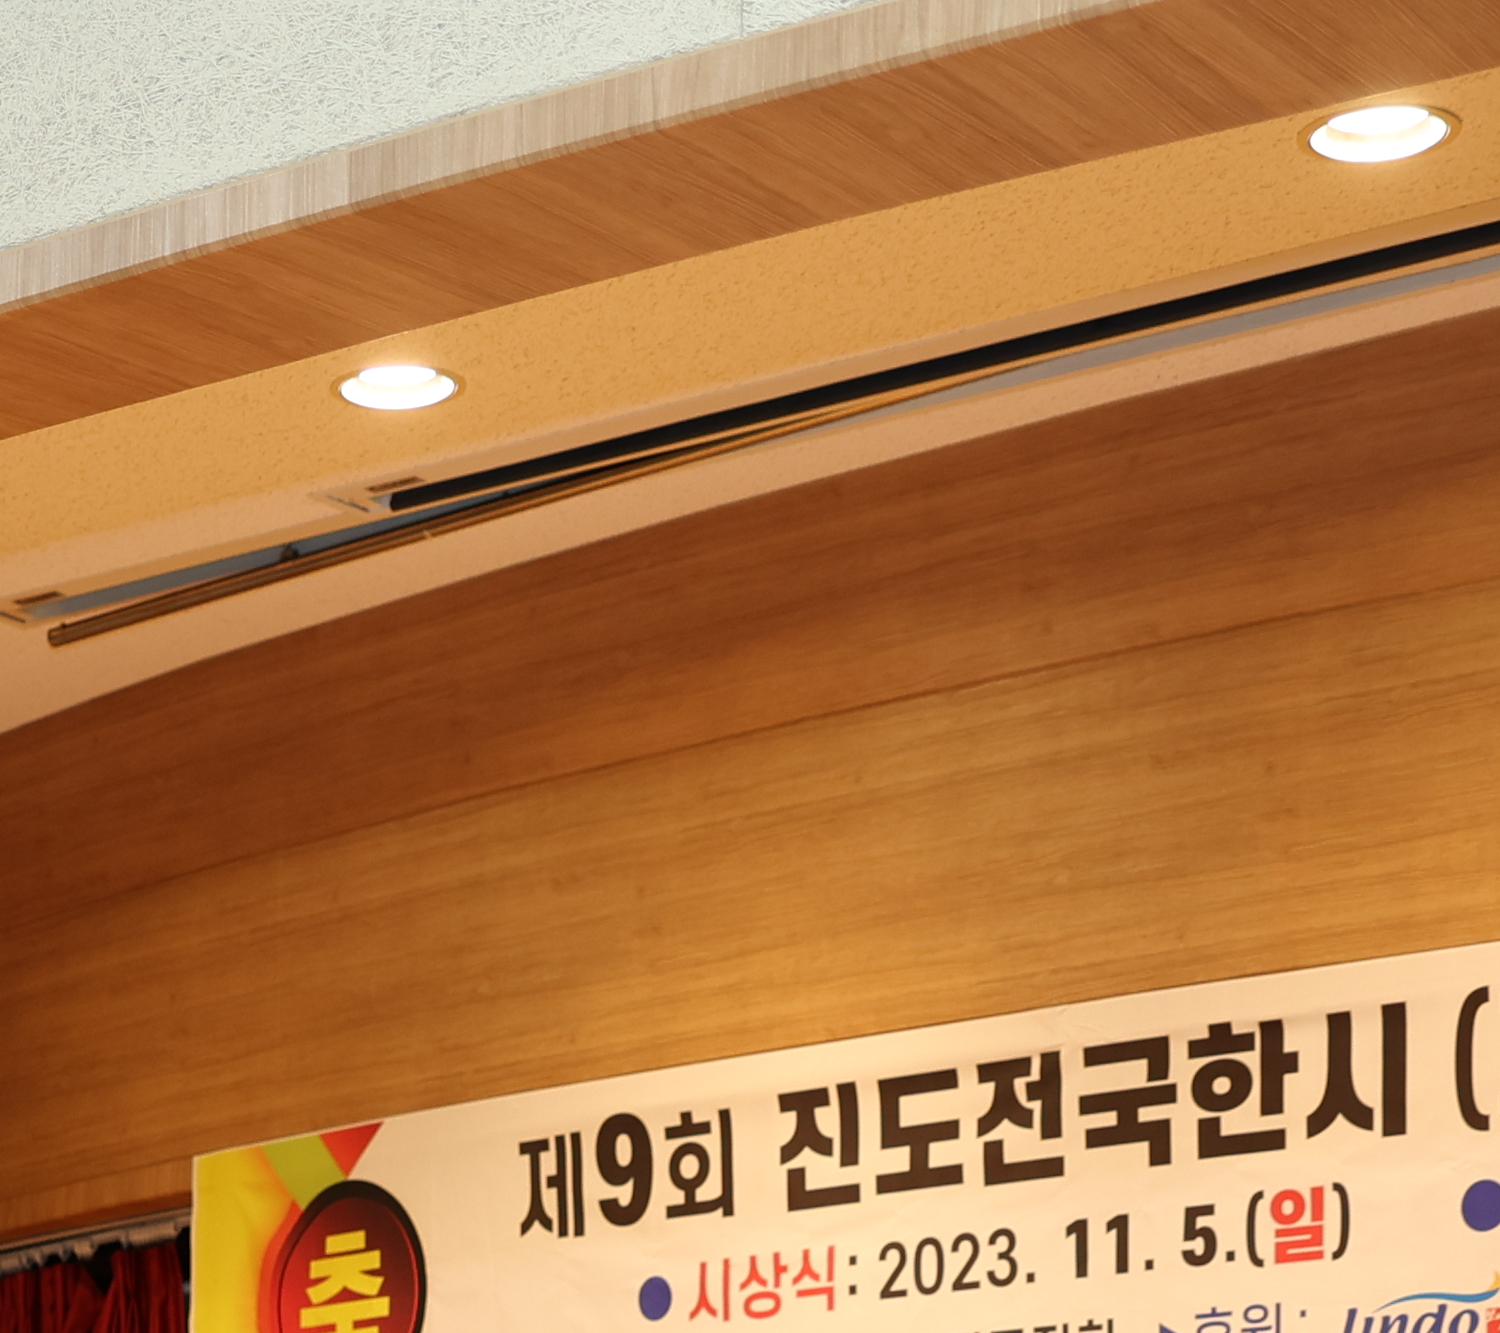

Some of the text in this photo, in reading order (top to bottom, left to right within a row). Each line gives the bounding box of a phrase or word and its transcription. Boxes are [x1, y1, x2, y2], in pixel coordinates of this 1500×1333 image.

[518, 1108, 734, 1238] 제9회
[777, 1001, 1407, 1213] 진도전국한시
[877, 1227, 1036, 1300] 2023.
[1065, 1212, 1155, 1280] 11.
